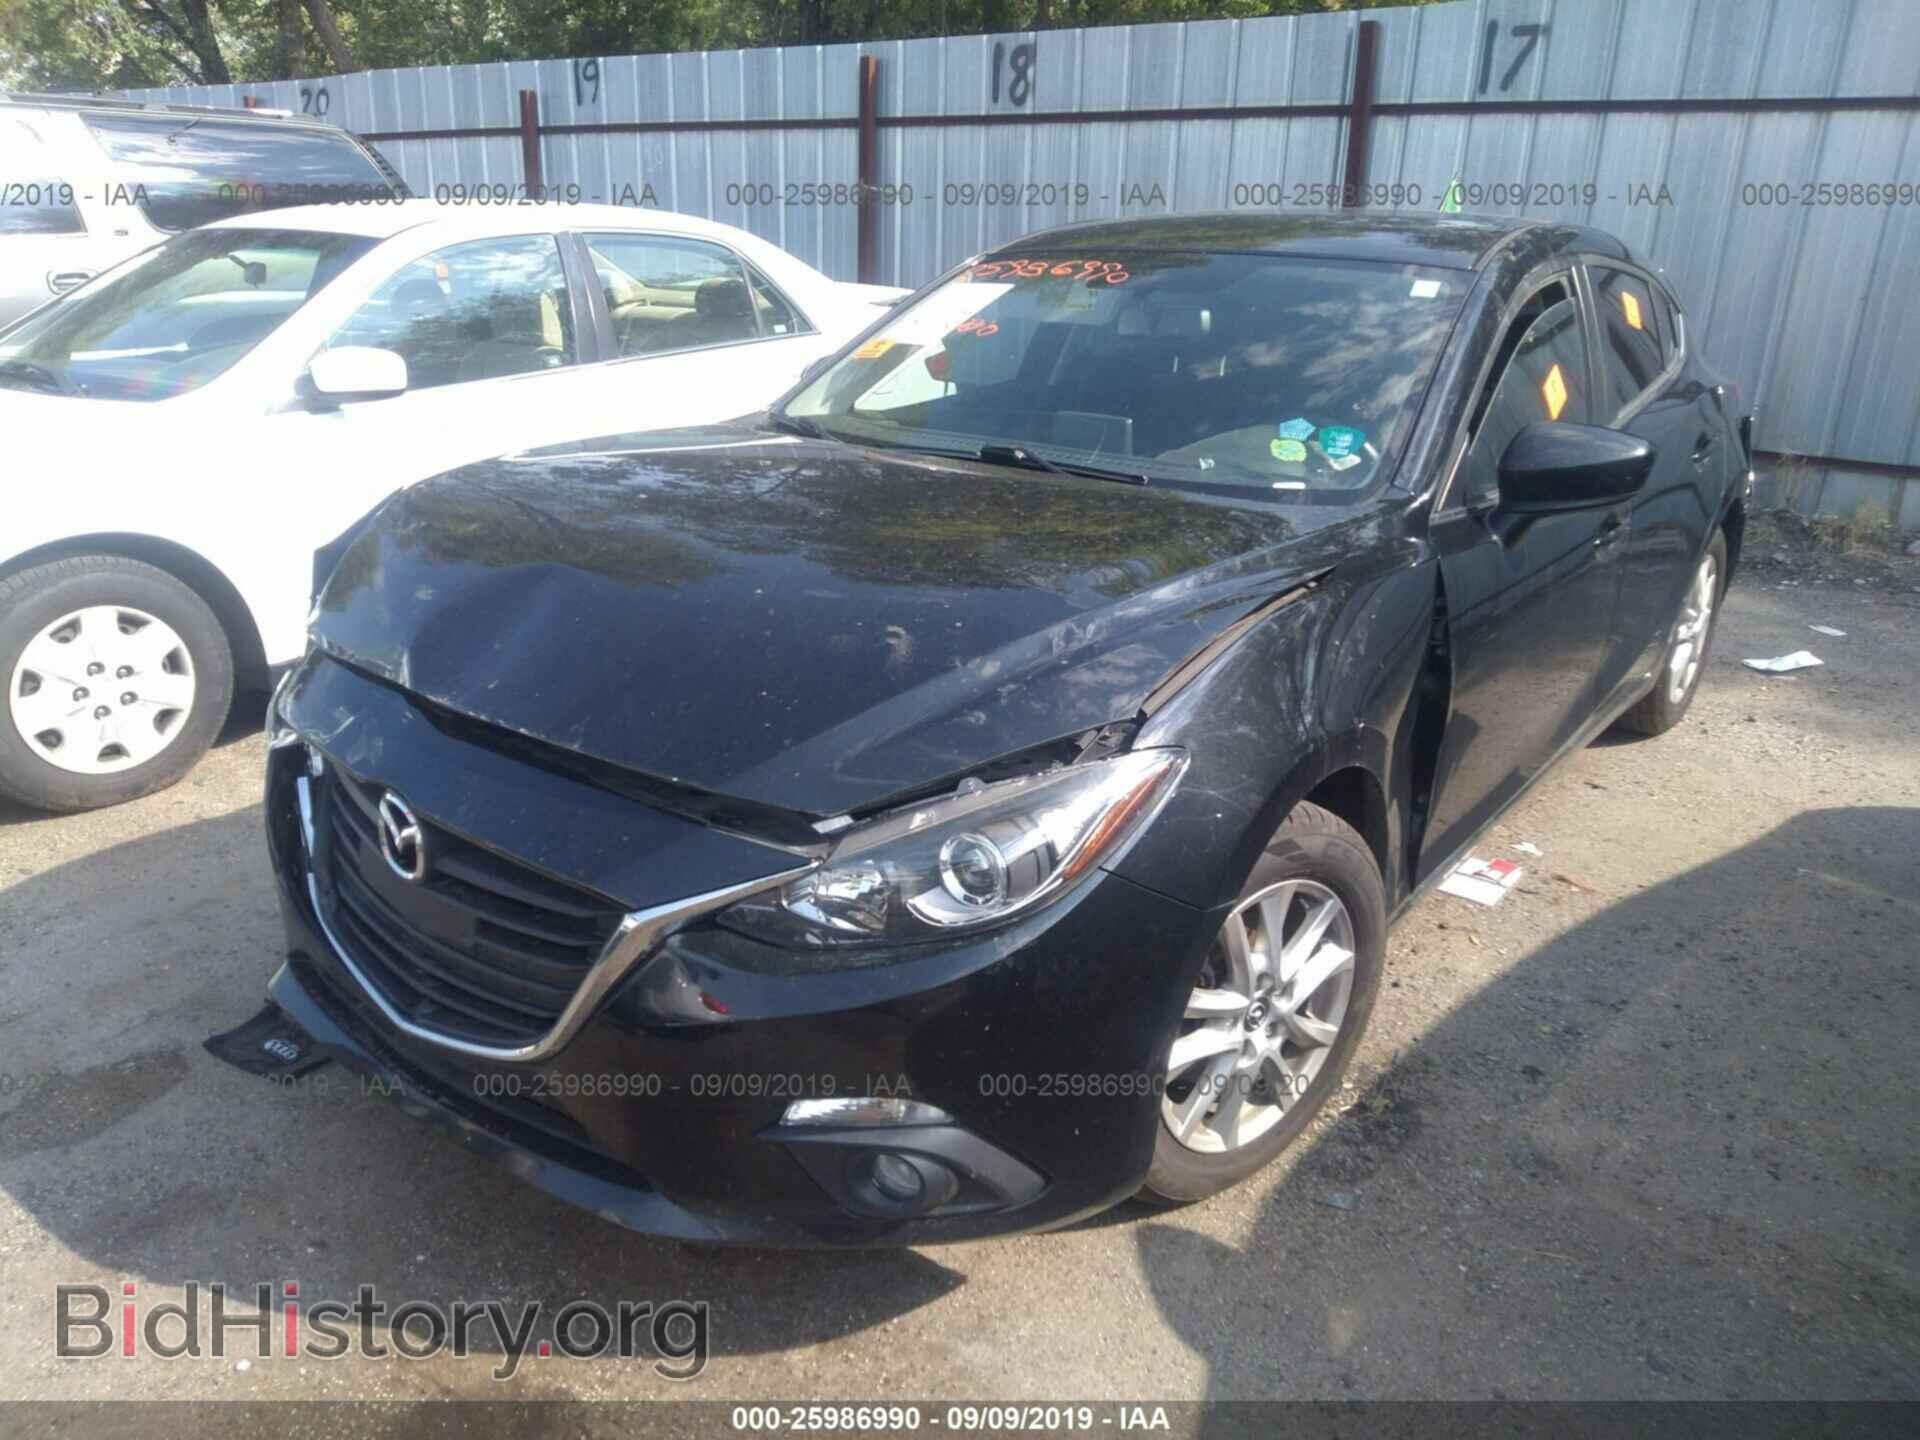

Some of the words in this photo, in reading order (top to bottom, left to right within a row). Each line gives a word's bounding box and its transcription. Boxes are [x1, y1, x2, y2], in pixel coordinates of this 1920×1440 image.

[573, 58, 600, 107] 19
[991, 41, 1035, 107] 18
[1479, 19, 1552, 95] 17
[299, 87, 330, 117] 20
